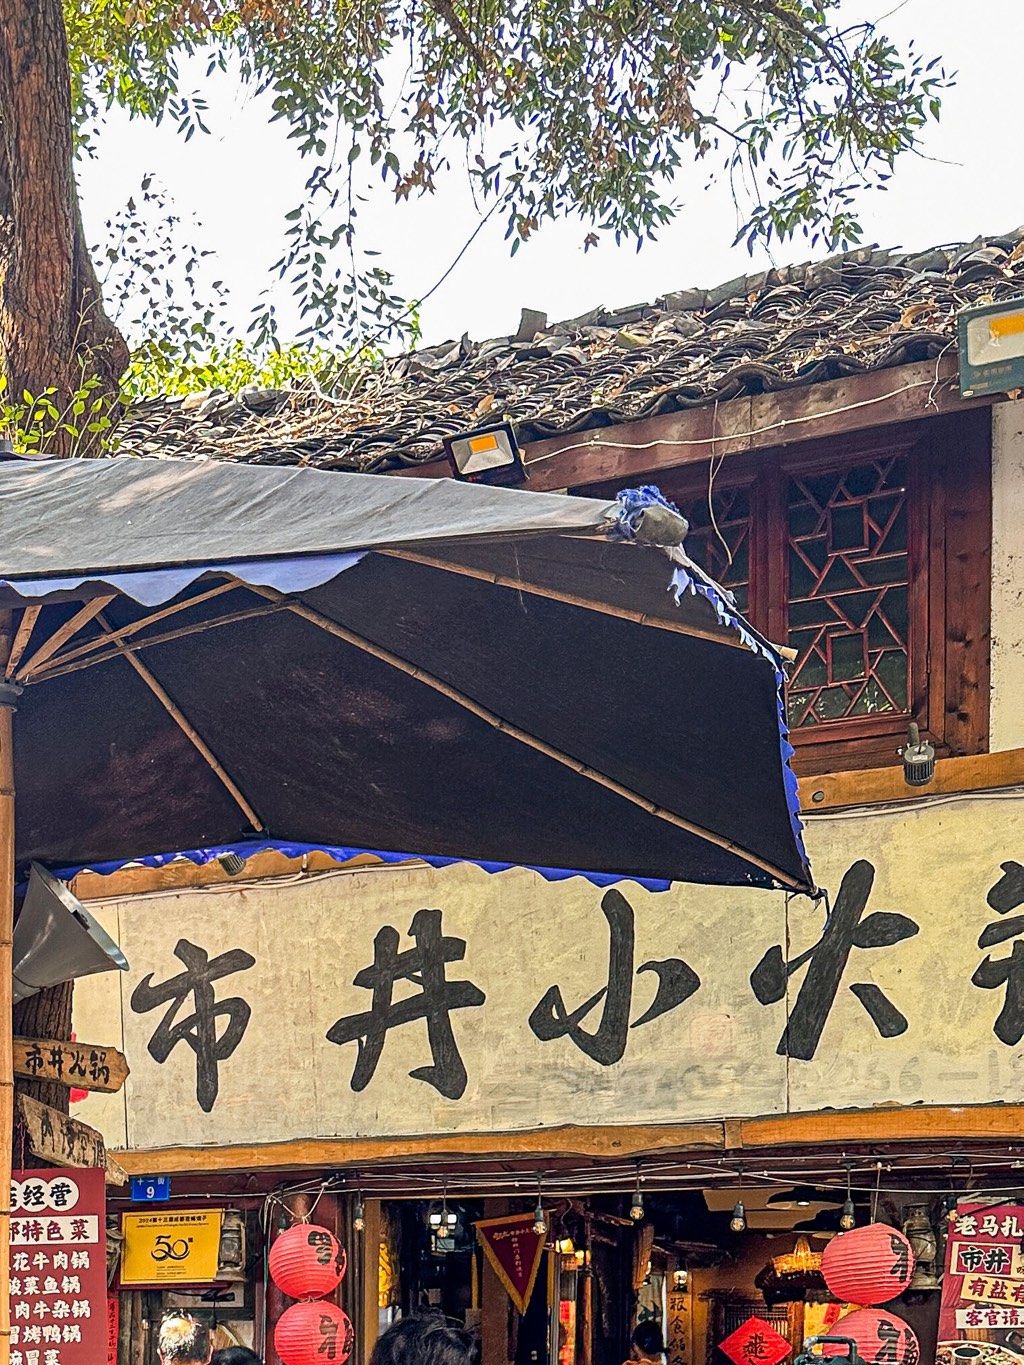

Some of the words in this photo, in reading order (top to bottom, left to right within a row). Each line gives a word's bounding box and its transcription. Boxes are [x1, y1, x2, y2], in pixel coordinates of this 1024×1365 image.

[25, 1043, 110, 1085] 市井火锅
[146, 1186, 155, 1199] 9
[954, 1215, 1024, 1237] 老马扎
[959, 1246, 1010, 1273] 市井
[966, 1309, 1024, 1327] 客官请
